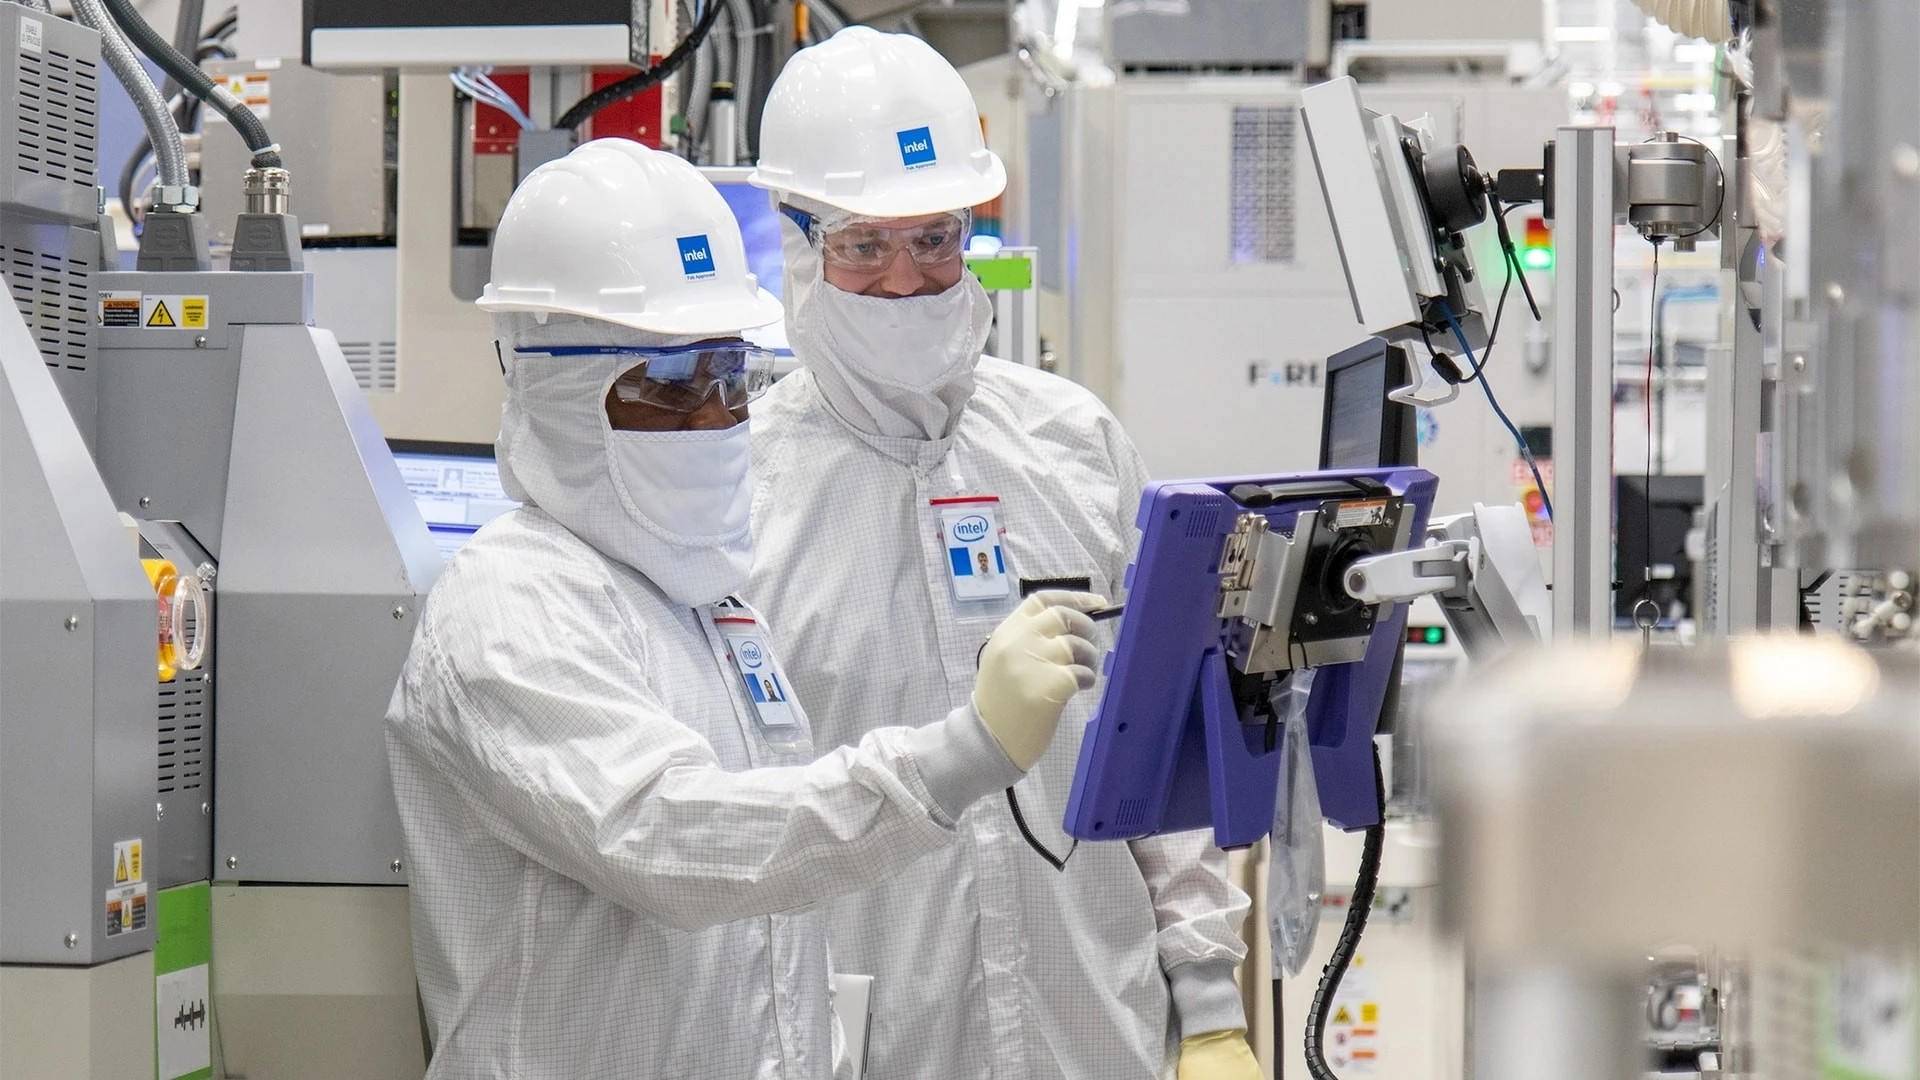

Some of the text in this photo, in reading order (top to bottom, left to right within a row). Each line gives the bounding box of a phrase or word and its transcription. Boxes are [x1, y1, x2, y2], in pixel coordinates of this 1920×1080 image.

[904, 139, 928, 154] intel
[683, 247, 707, 261] intel
[956, 521, 985, 535] intel
[741, 648, 759, 661] intel
